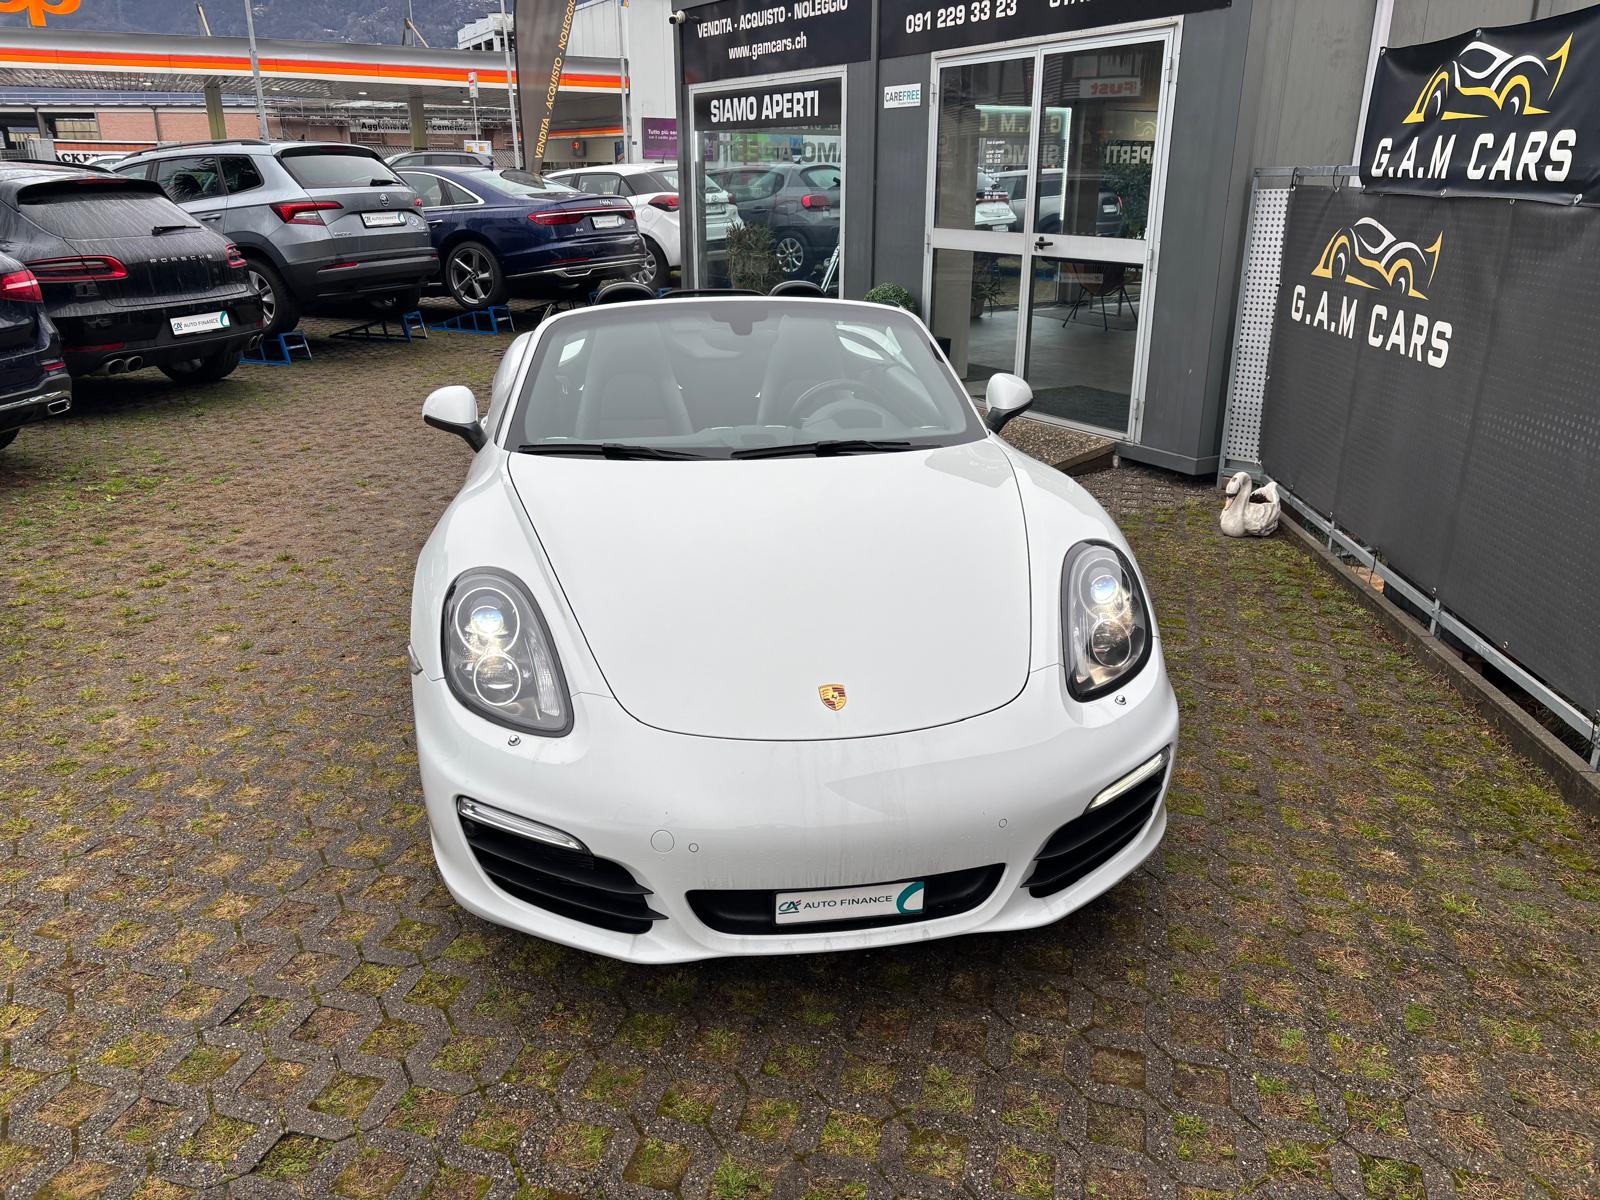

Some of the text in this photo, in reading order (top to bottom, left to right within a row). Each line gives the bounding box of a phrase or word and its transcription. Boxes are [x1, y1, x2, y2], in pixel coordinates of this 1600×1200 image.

[697, 17, 733, 38] VENDITA
[739, 6, 786, 31] ACQUISTO
[794, 0, 848, 20] NOLEGGIO
[905, 0, 1017, 34] 091 229 33 23
[728, 31, 807, 60] www.gamcars.ch
[535, 118, 550, 159] VENDITA
[545, 57, 562, 109] ACQUISTO
[710, 90, 819, 123] SIAMO APERTI
[885, 90, 920, 102] CAREFREE
[361, 122, 410, 131] Agglomerat
[1371, 129, 1577, 182] G.A.M CARS
[150, 254, 212, 263] PORSCHE
[198, 317, 219, 326] FINANCE
[1291, 284, 1453, 369] G.A.M CARS
[804, 900, 837, 909] AUTO
[840, 895, 893, 906] FINANCE
